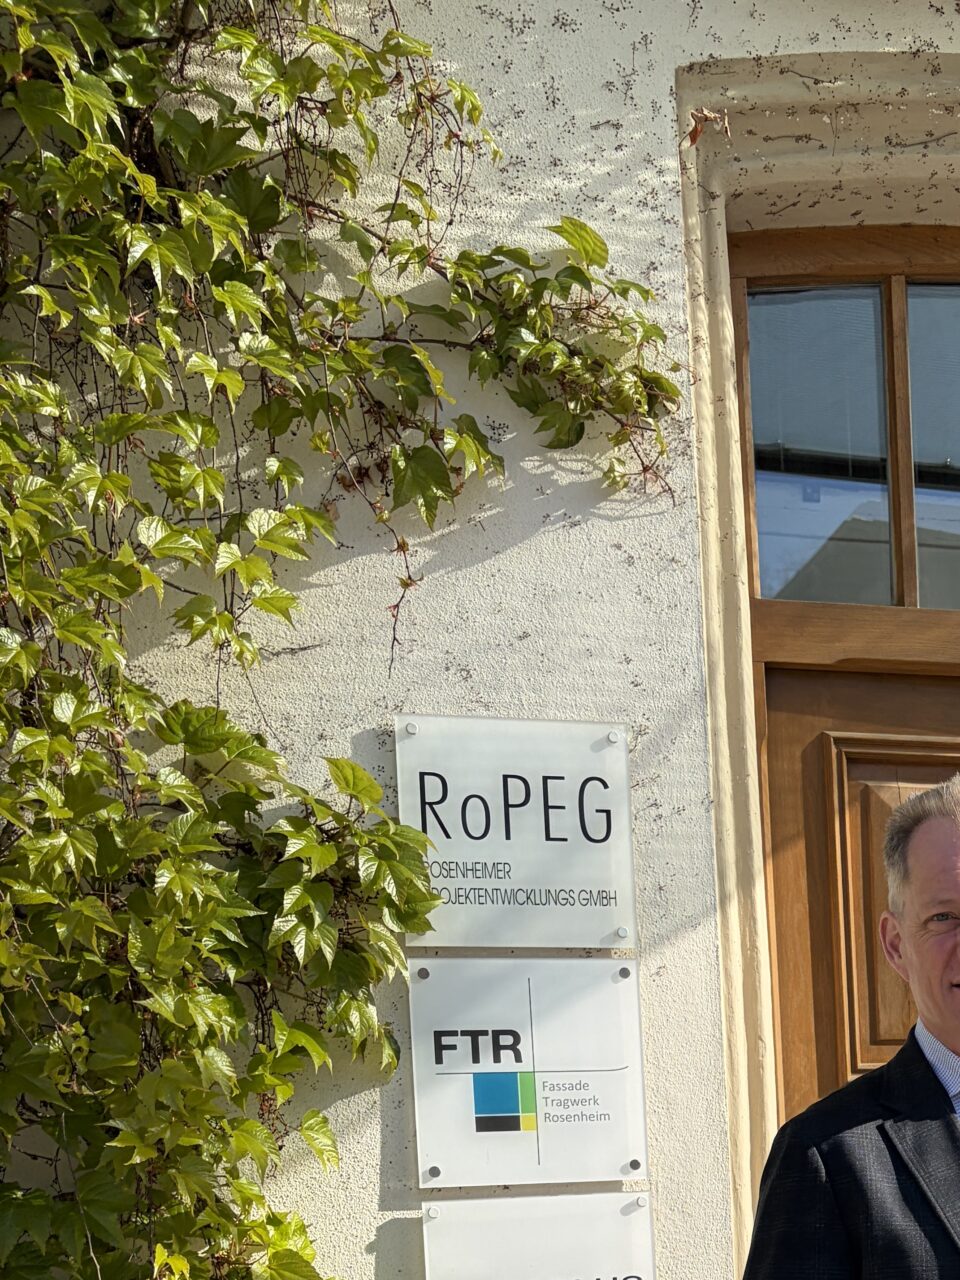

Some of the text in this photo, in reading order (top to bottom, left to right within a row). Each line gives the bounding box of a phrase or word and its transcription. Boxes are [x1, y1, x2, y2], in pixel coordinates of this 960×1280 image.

[419, 771, 612, 843] RoPEG
[424, 861, 511, 879] OSENHEIMER
[430, 887, 617, 907] OJEKTENTWICKLUNGS GMBH
[433, 1029, 523, 1065] FTR
[542, 1080, 590, 1092] Fassade
[542, 1095, 600, 1108] Tragwerk
[544, 1111, 611, 1123] Rosenheim
